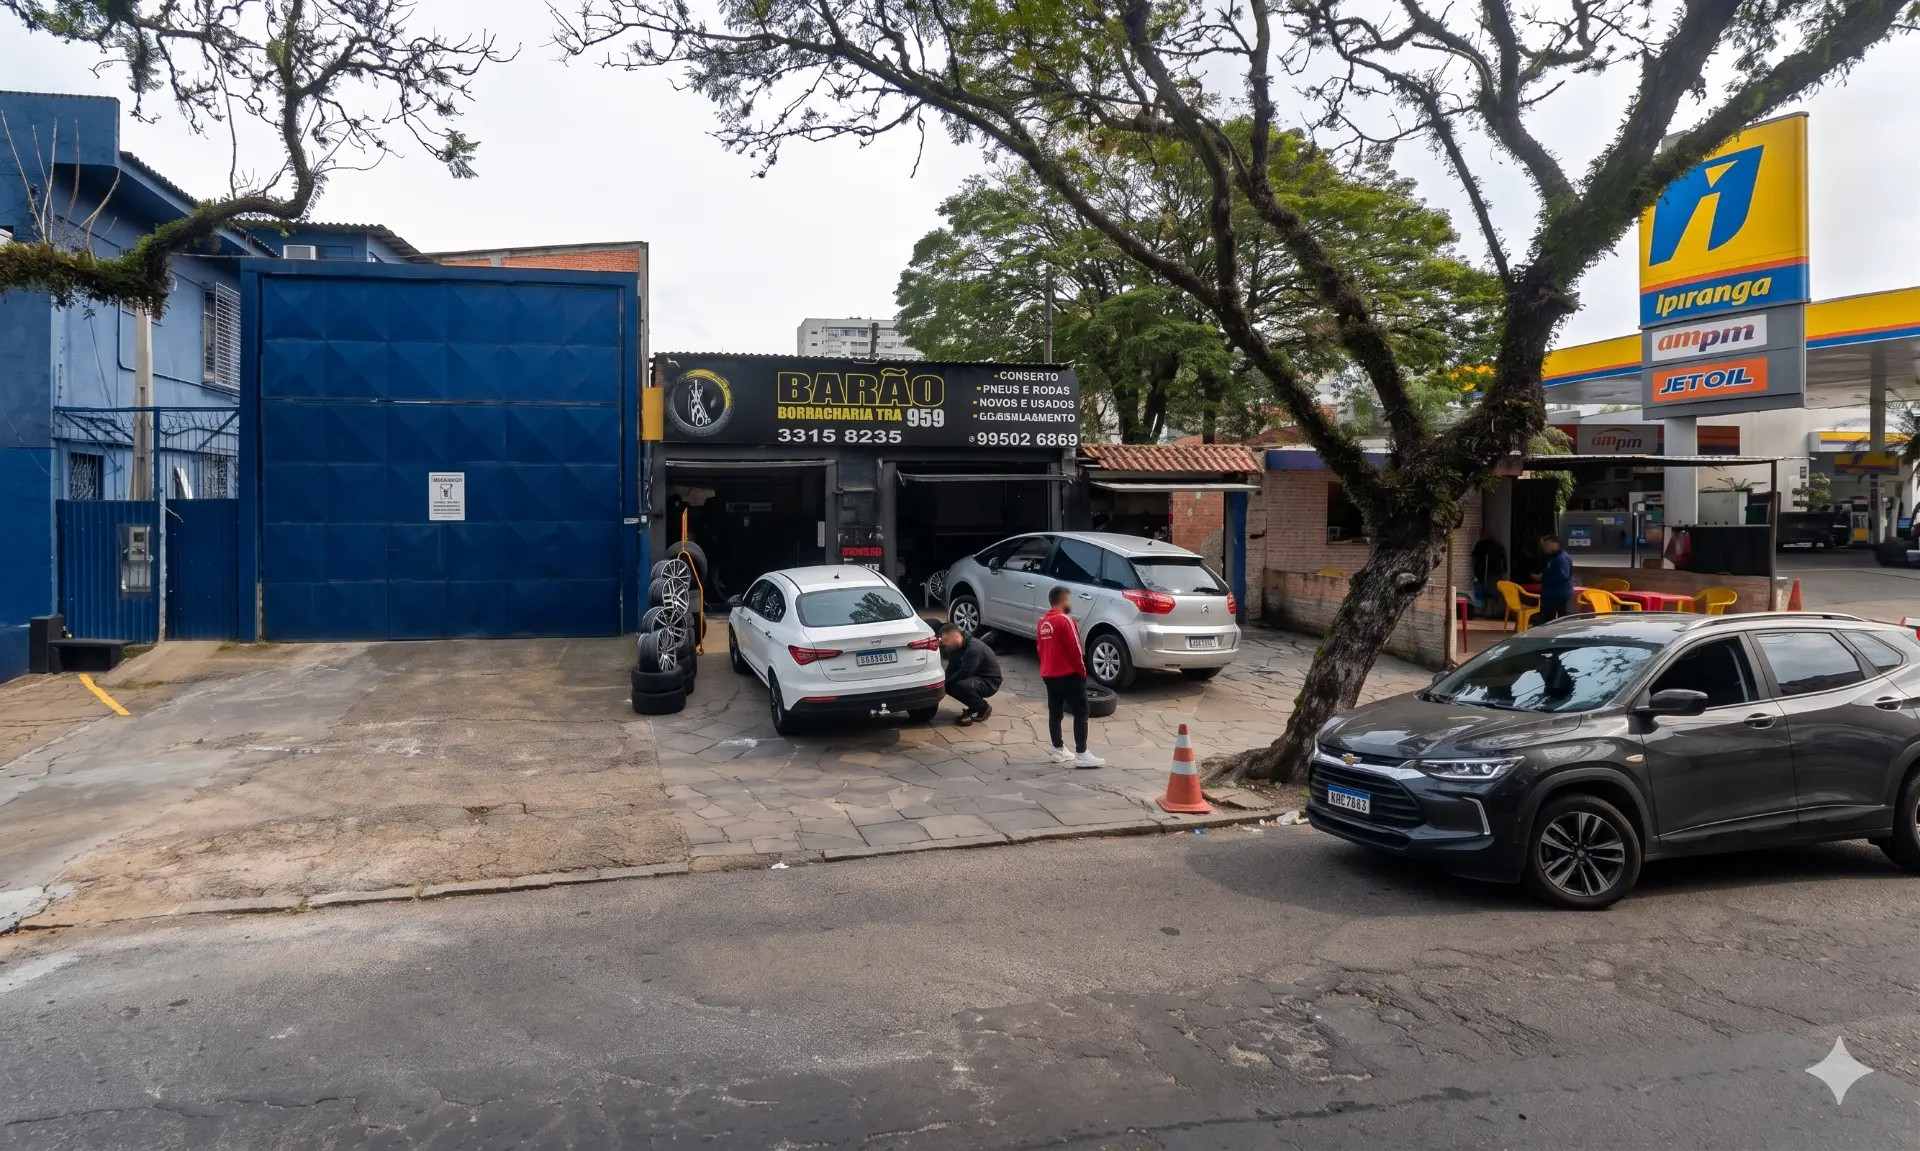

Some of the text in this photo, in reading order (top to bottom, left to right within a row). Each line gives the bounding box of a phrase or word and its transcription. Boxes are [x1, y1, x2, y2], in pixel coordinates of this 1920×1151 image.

[1655, 277, 1772, 318] Ipiranga
[1657, 324, 1755, 352] ampm
[1000, 371, 1059, 382] CONSERTO
[777, 368, 945, 407] BARÃO
[983, 385, 1071, 395] PNEUS E RODAS
[979, 398, 1075, 409] NOVOS E USADOS
[777, 406, 945, 427] BORRACHARIA TRA 959
[777, 429, 902, 443] 3315 8235
[977, 432, 1078, 446] 99502 6869
[1591, 436, 1643, 452] ampm
